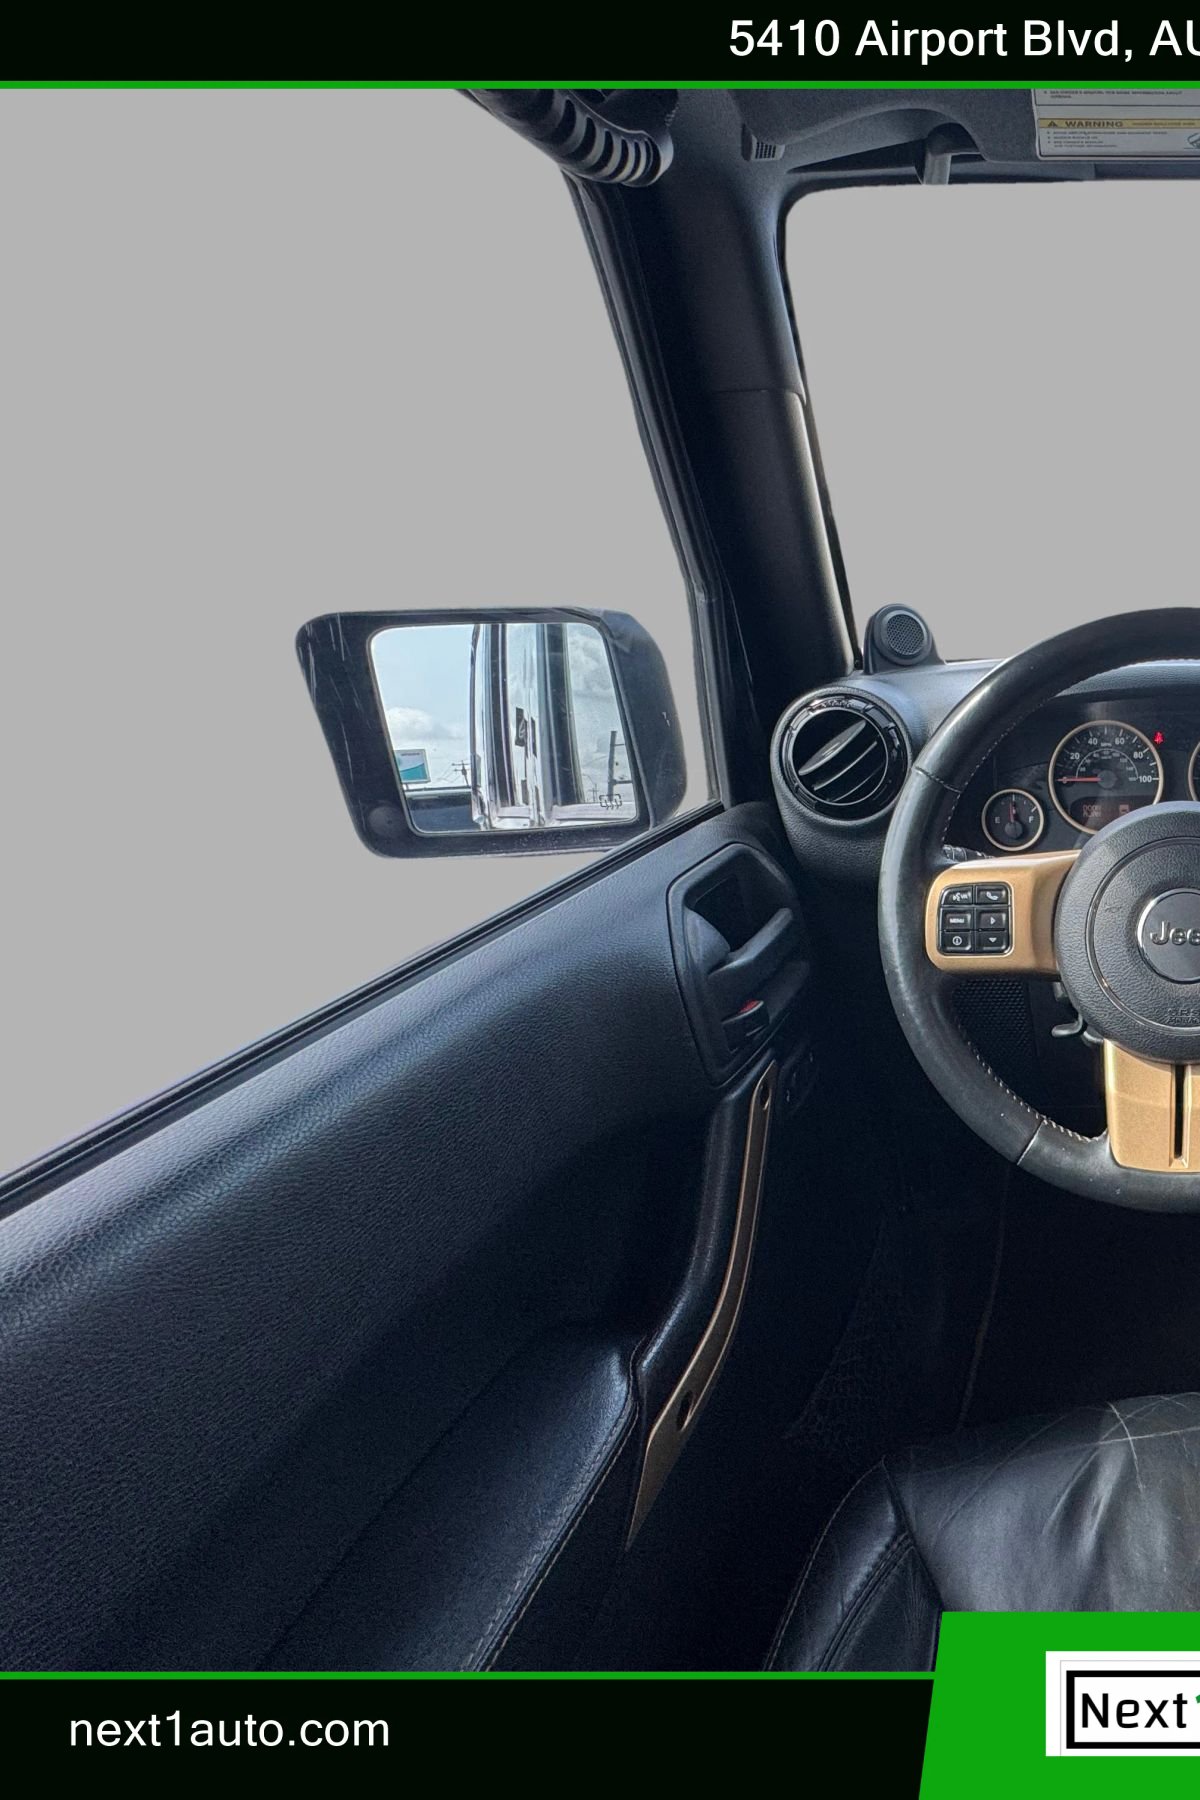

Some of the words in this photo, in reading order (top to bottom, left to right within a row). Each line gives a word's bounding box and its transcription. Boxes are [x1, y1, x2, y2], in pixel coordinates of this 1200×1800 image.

[1065, 120, 1123, 128] WARNING
[1115, 737, 1125, 745] 60
[1070, 752, 1080, 760] 20
[1139, 775, 1152, 783] 100
